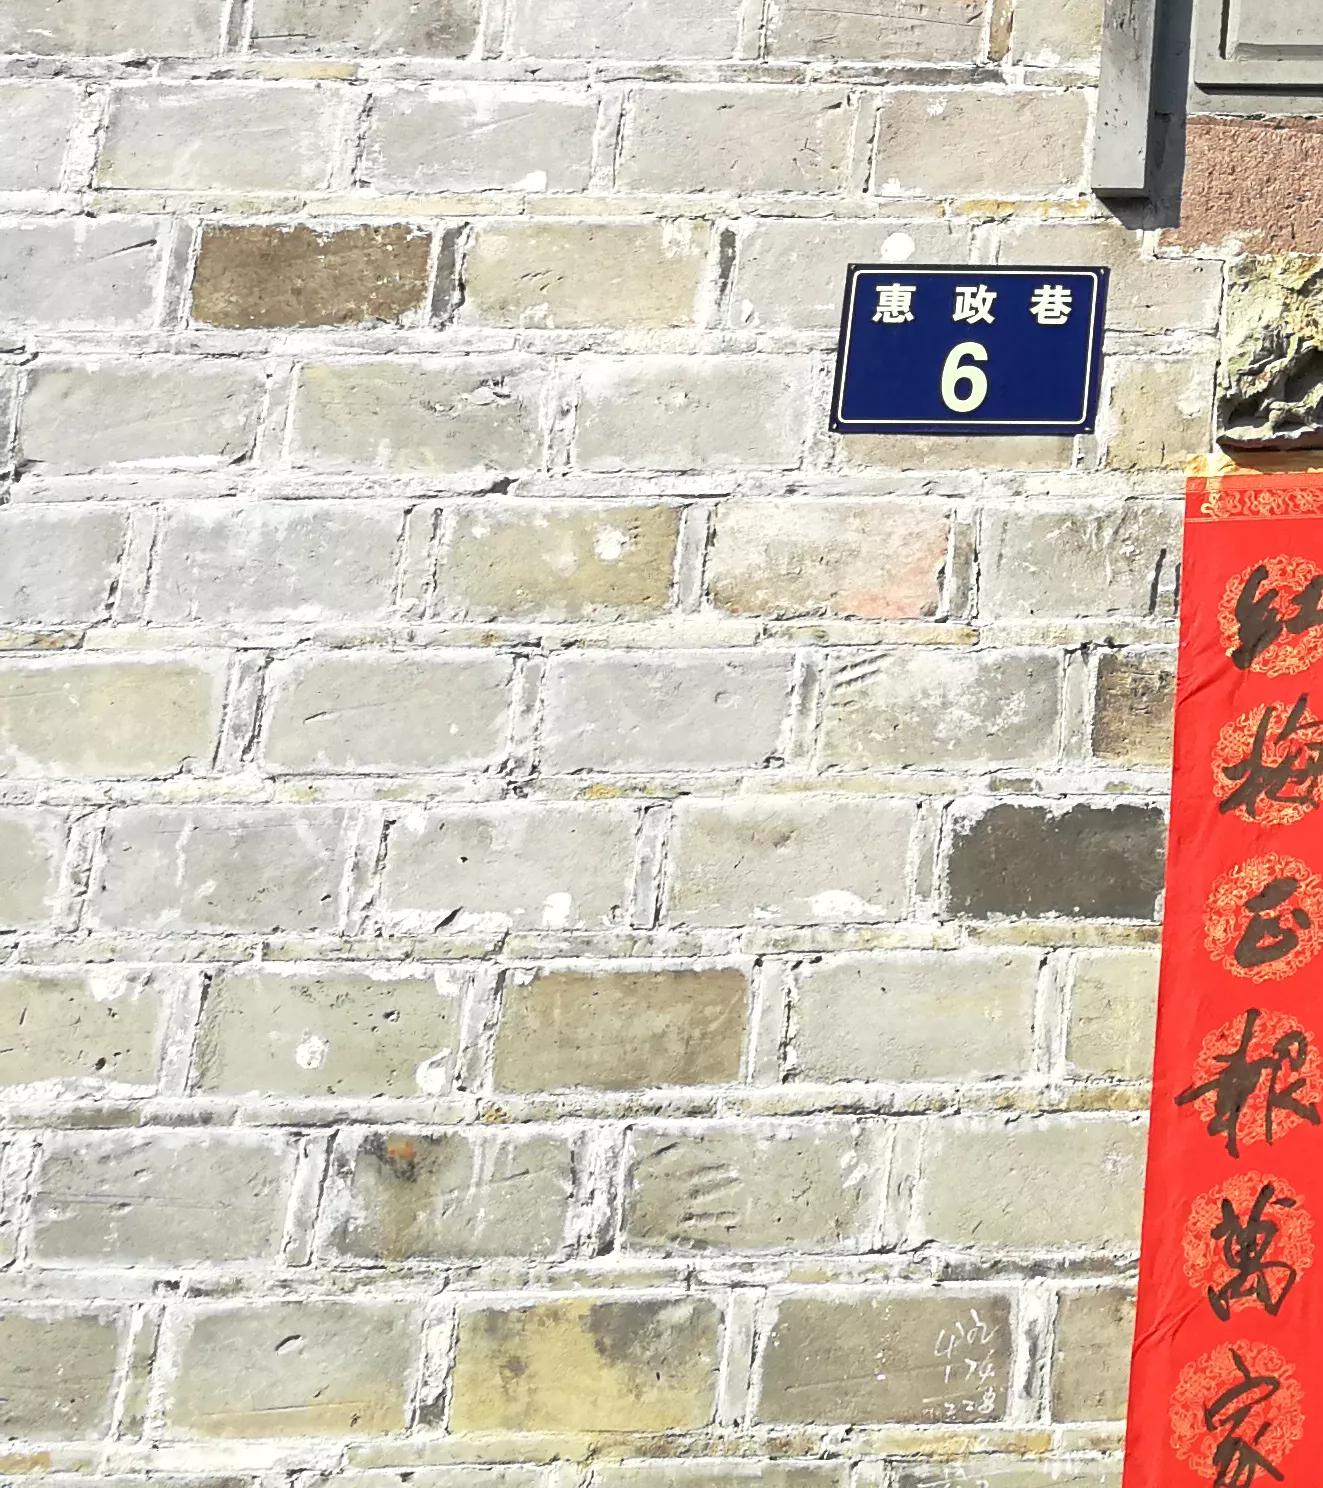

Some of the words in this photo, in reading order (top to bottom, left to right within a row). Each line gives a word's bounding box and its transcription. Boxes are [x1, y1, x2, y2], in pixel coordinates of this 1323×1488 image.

[872, 282, 1073, 325] 惠政巷
[941, 341, 988, 413] 6
[944, 1348, 996, 1385] 174
